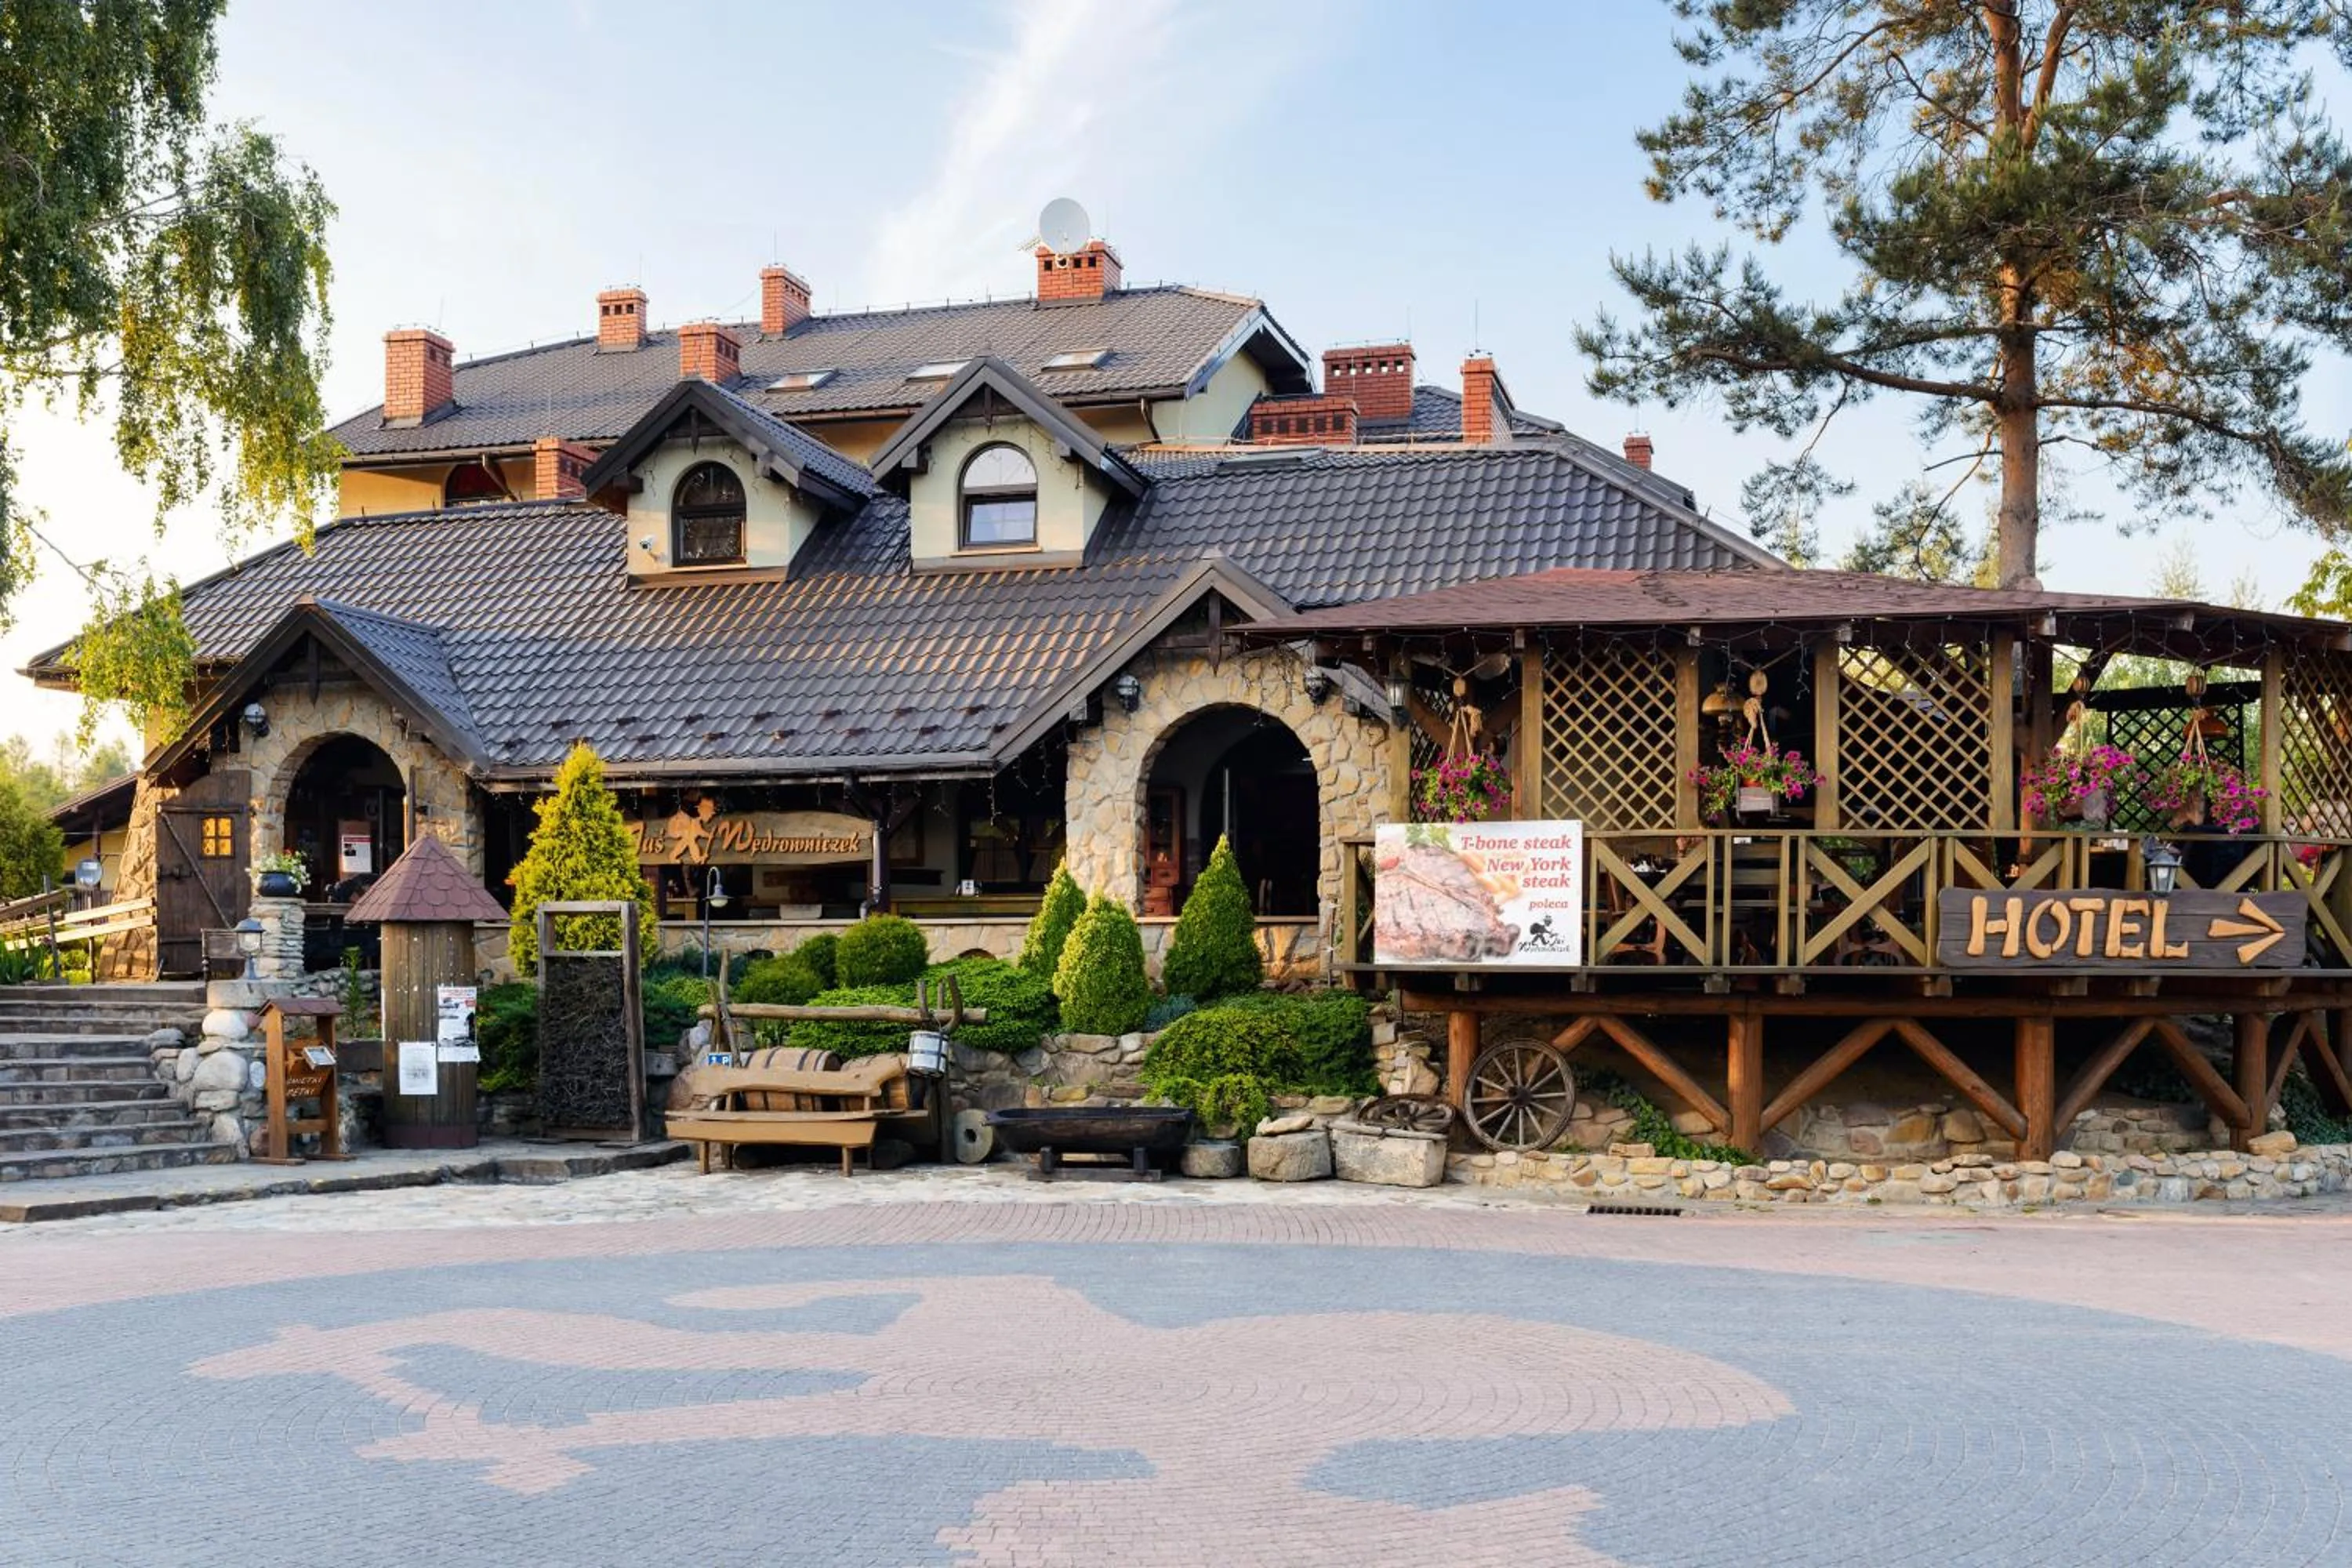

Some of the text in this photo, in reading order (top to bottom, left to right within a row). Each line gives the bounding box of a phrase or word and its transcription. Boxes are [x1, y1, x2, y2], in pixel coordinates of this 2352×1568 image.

[717, 820, 859, 857] Wędrowniczek
[1461, 834, 1572, 851] T-bone steak
[1487, 856, 1571, 873] New York
[1522, 873, 1570, 888] steak
[1528, 898, 1569, 911] poleca
[1967, 896, 2188, 959] HOTEL
